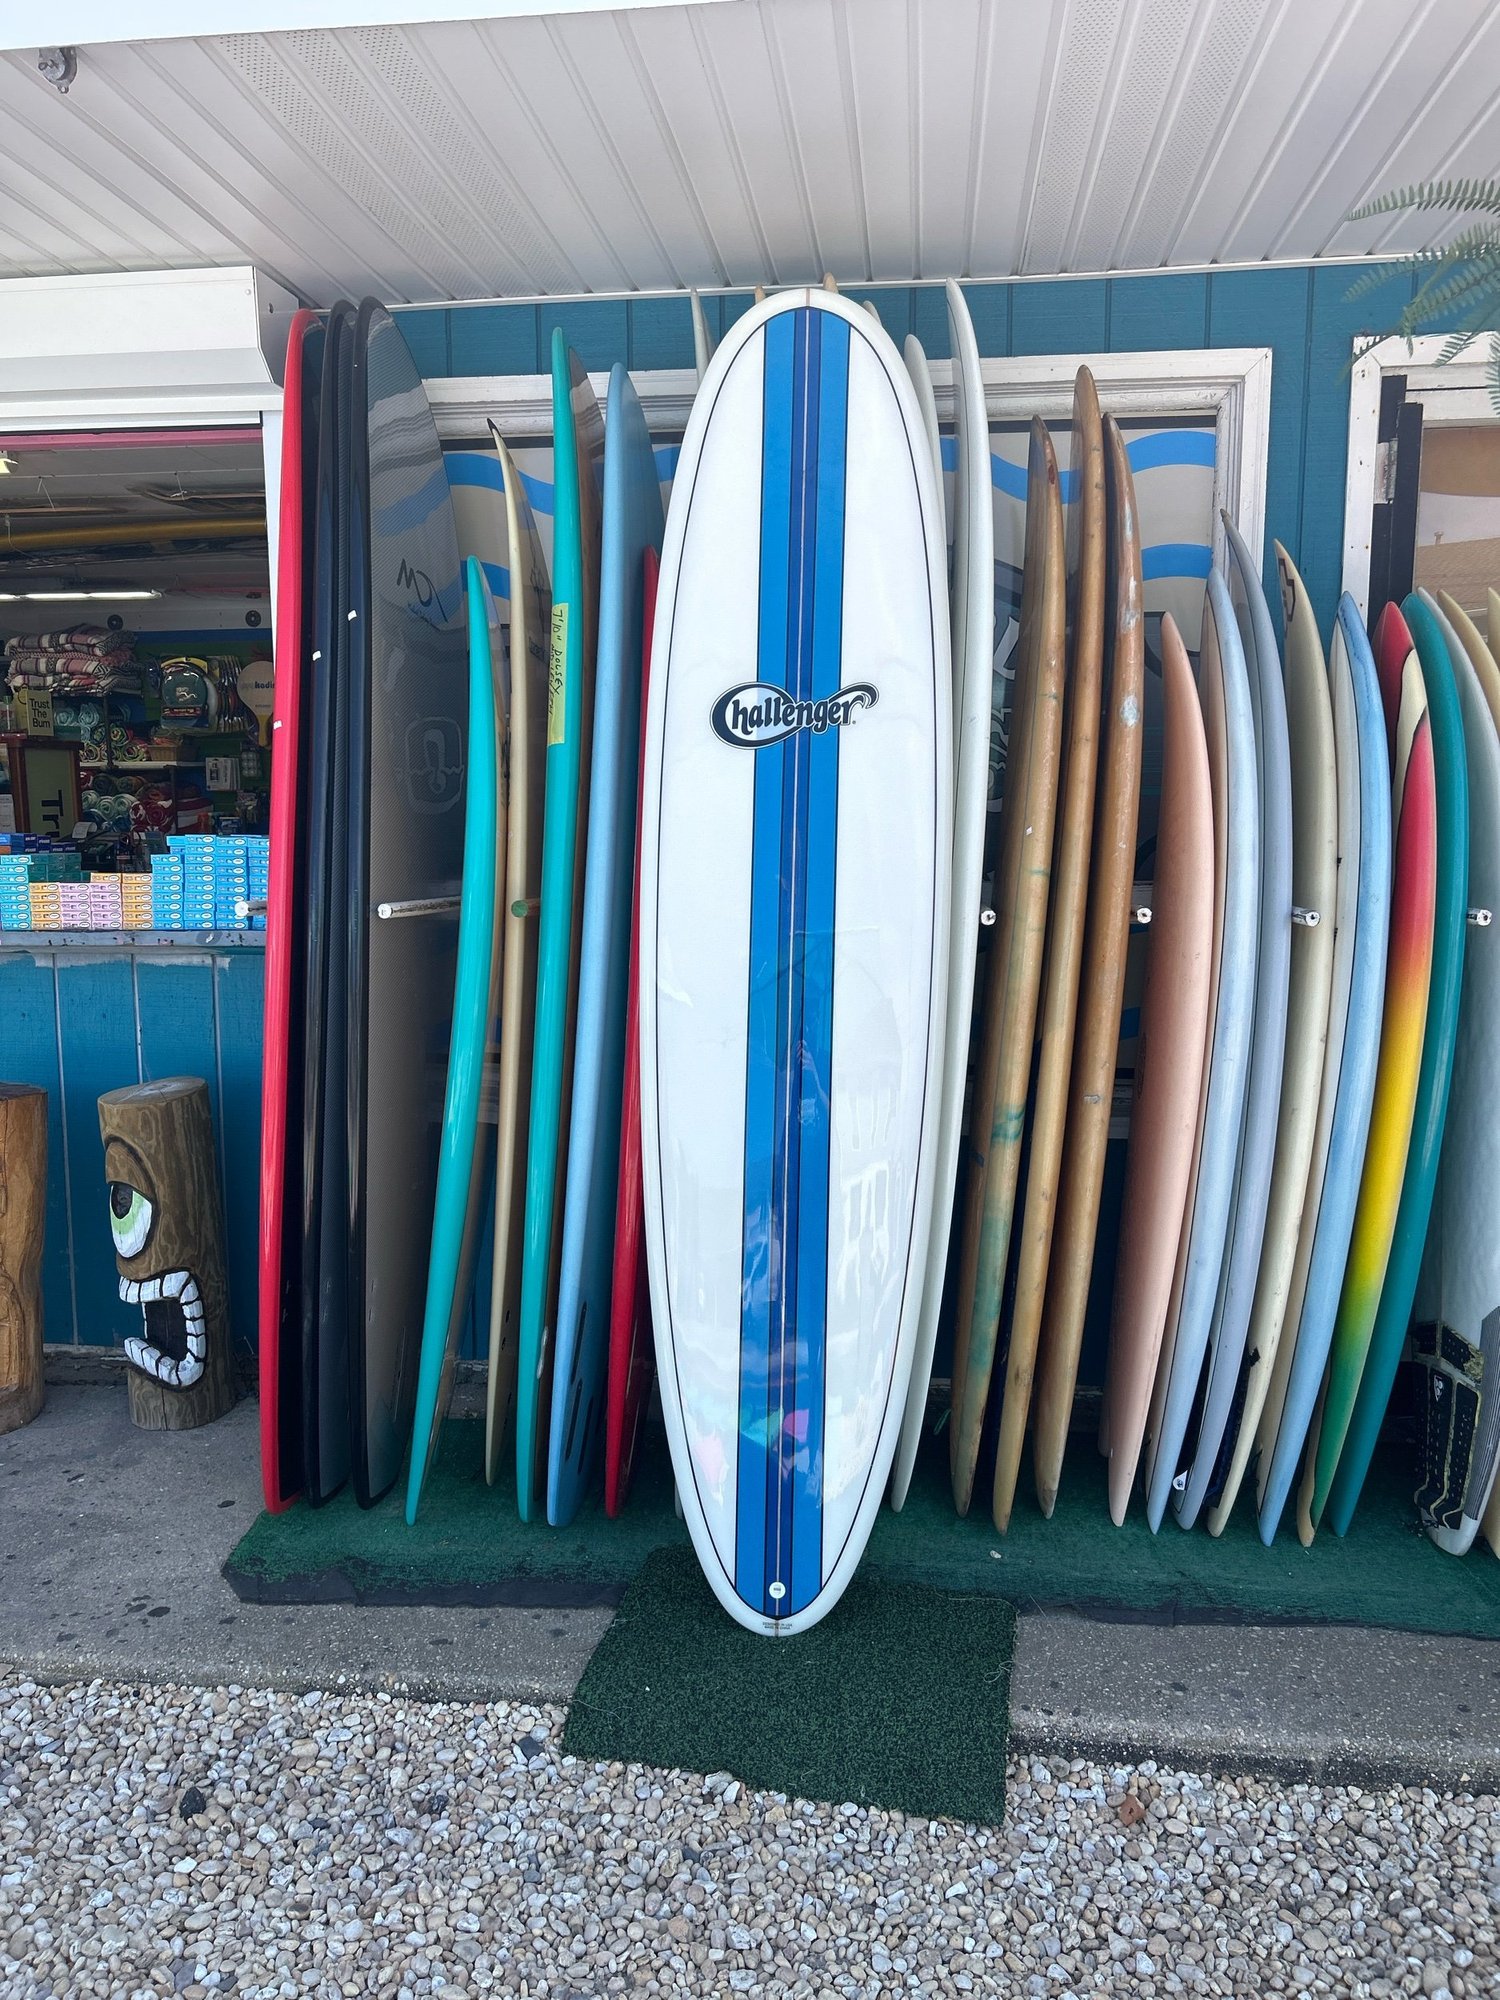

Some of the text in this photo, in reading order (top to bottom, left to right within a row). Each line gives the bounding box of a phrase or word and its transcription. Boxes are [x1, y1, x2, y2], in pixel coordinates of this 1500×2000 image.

[29, 698, 50, 710] Trust
[32, 708, 48, 719] The
[709, 681, 880, 750] Challenger
[32, 717, 51, 729] Bum
